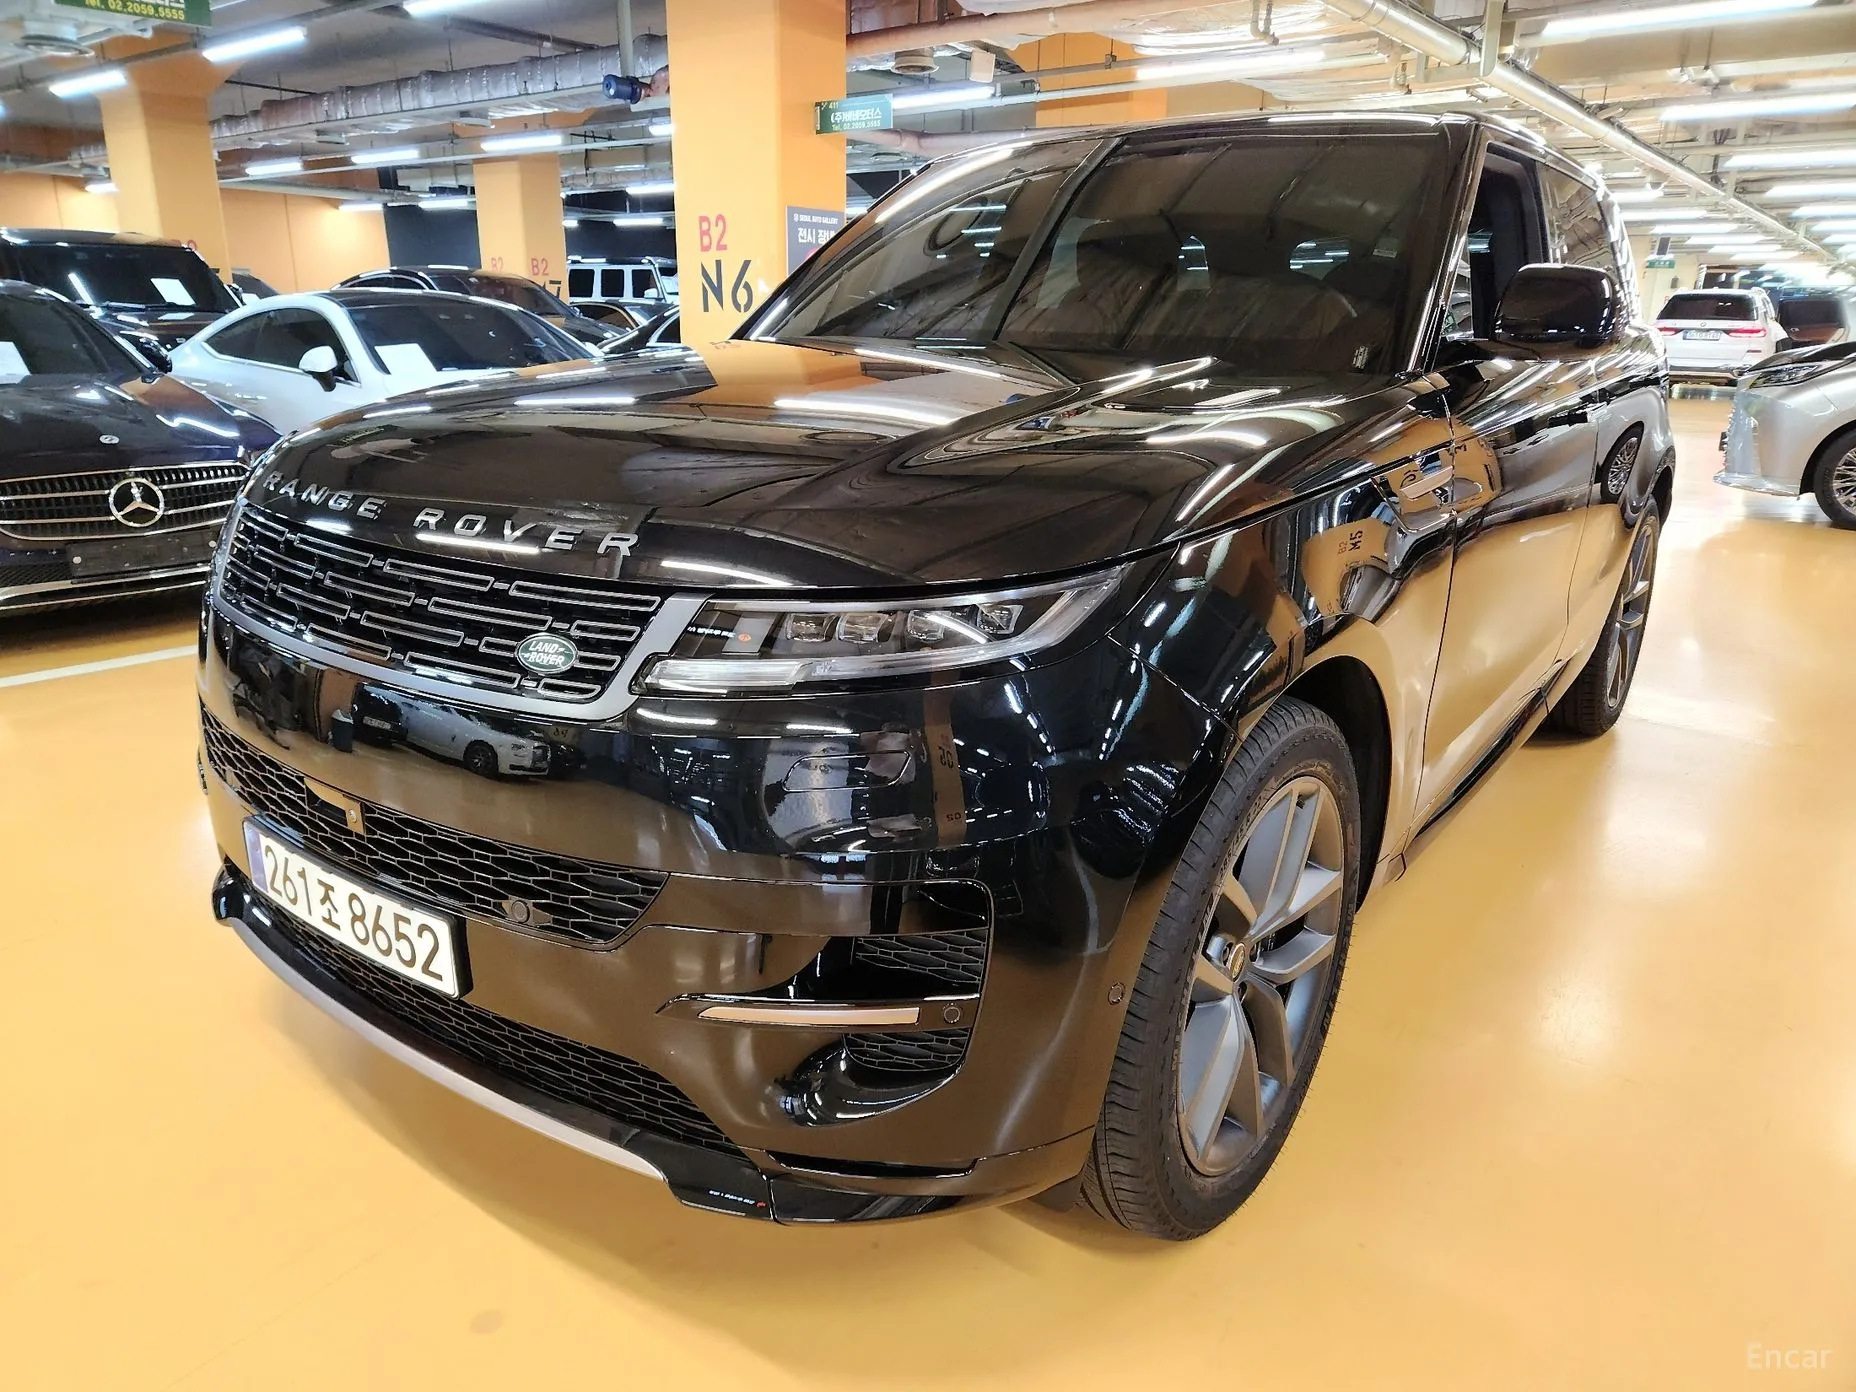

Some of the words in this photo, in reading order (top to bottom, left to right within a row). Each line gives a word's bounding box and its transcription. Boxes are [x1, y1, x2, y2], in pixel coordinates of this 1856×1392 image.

[799, 214, 811, 222] SEOUL
[812, 215, 822, 223] AUTO
[822, 216, 839, 225] GALLERY
[698, 214, 728, 252] B2
[797, 227, 816, 244] 전시
[531, 258, 549, 276] B2
[700, 259, 754, 313] N6
[262, 470, 388, 520] RANGE
[412, 507, 640, 557] ROVER
[528, 641, 560, 654] LAND
[527, 651, 566, 666] ROVER
[264, 844, 342, 932] 261조
[348, 892, 443, 982] 8652
